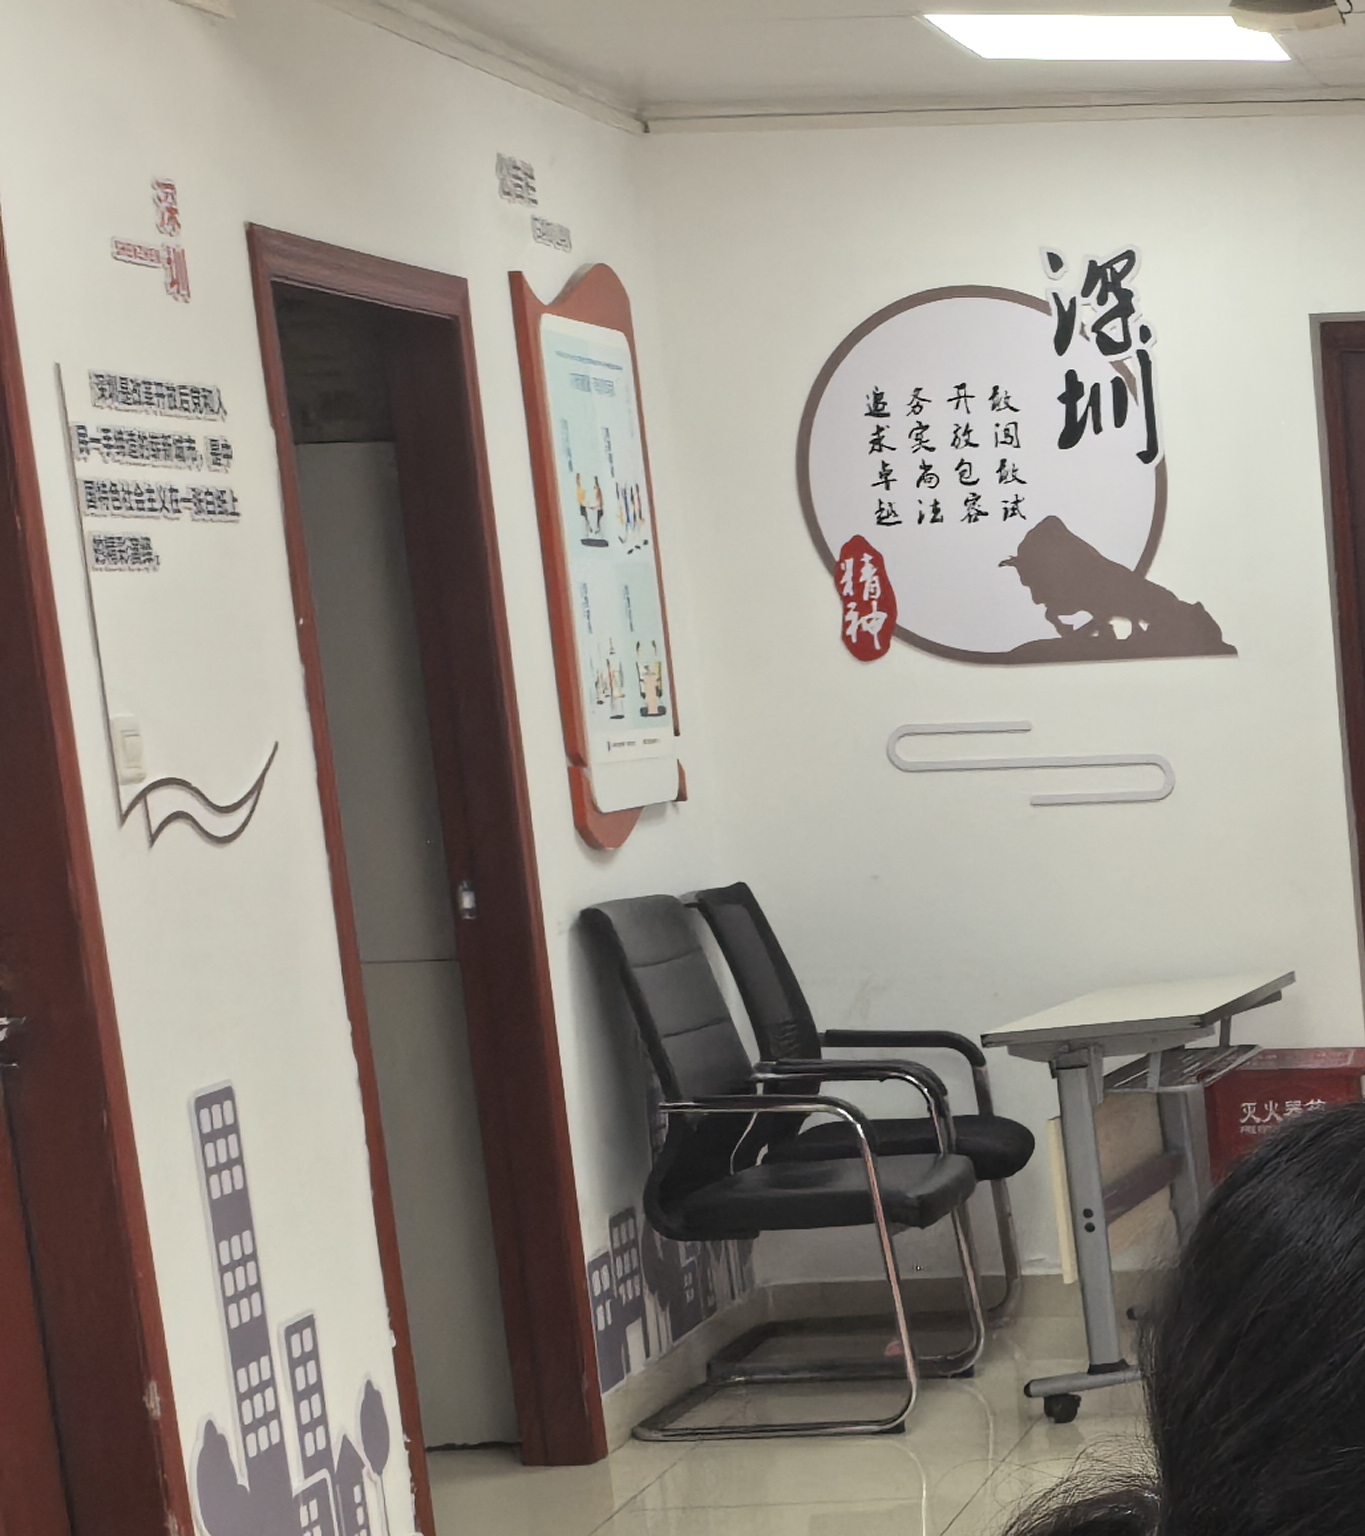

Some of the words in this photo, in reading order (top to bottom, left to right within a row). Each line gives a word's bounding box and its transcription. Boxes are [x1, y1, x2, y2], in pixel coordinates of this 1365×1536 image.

[1044, 248, 1158, 464] 深圳
[864, 385, 903, 528] 追求卓越
[906, 385, 944, 525] 务实尚法
[946, 382, 989, 524] 开放包容
[987, 384, 1028, 523] 敢闯敢试
[839, 553, 888, 651] 精神
